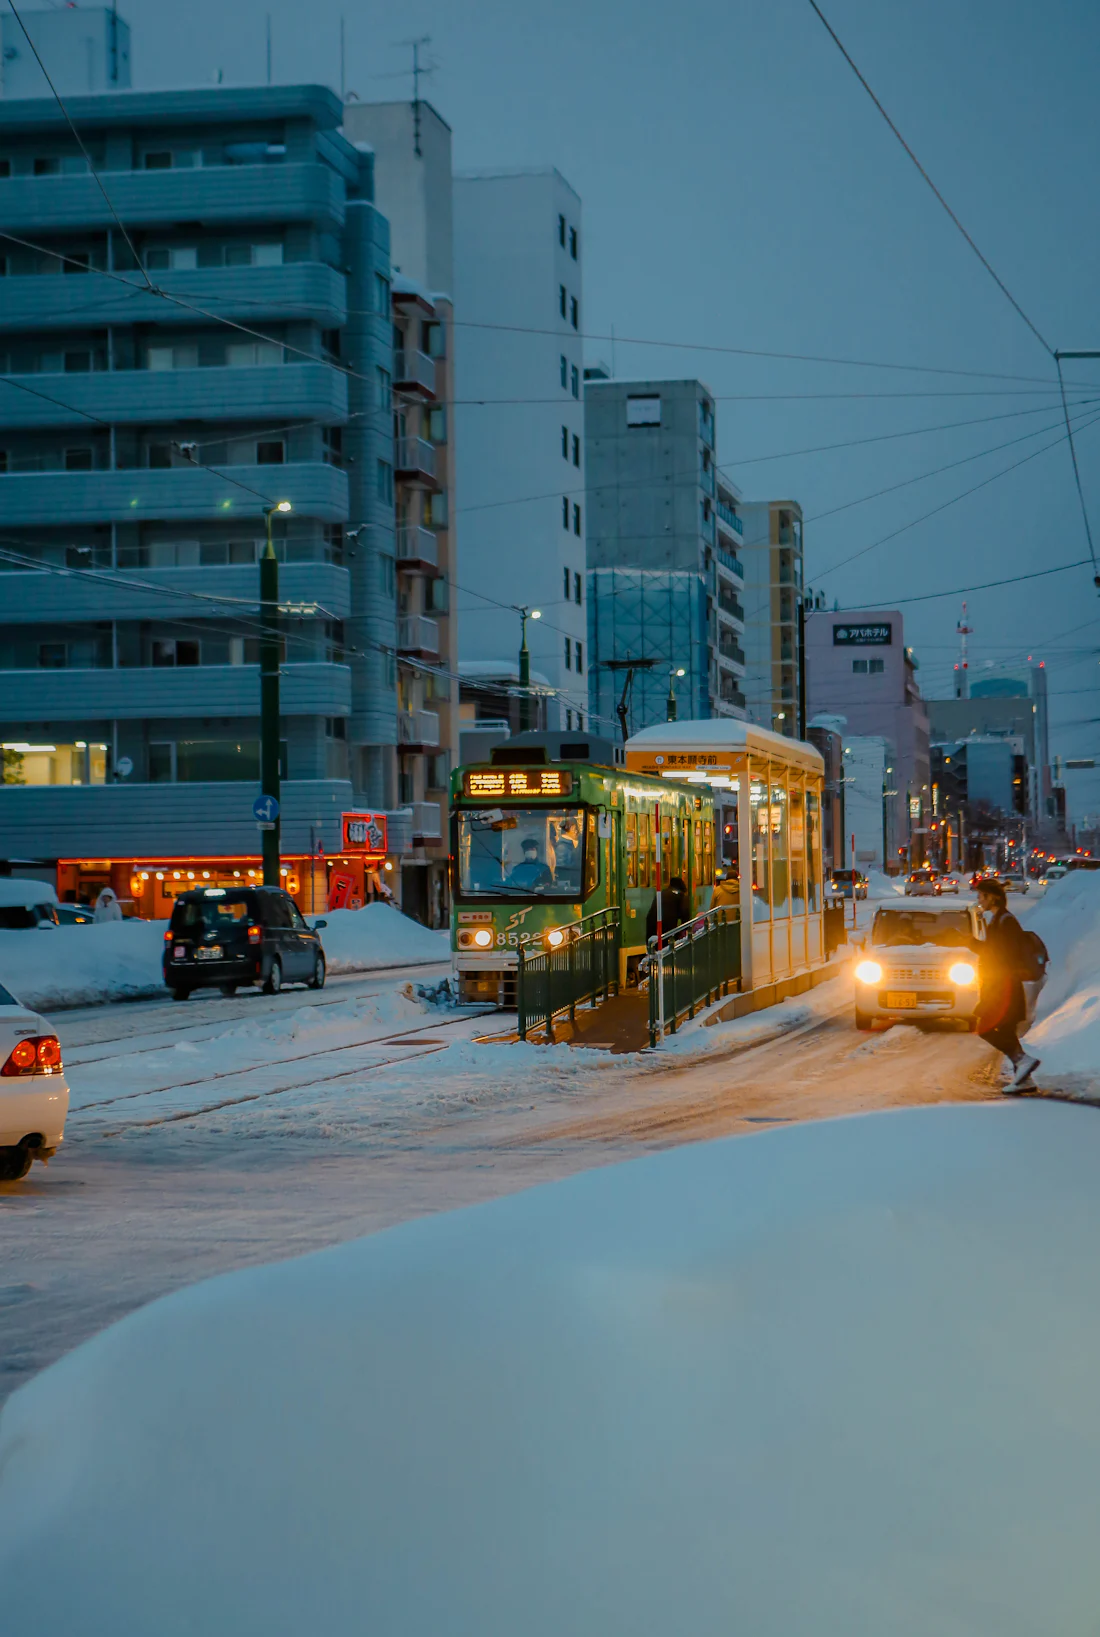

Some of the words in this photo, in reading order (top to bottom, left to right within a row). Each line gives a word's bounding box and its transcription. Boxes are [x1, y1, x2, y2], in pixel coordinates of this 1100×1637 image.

[668, 755, 717, 765] 東本願寺前
